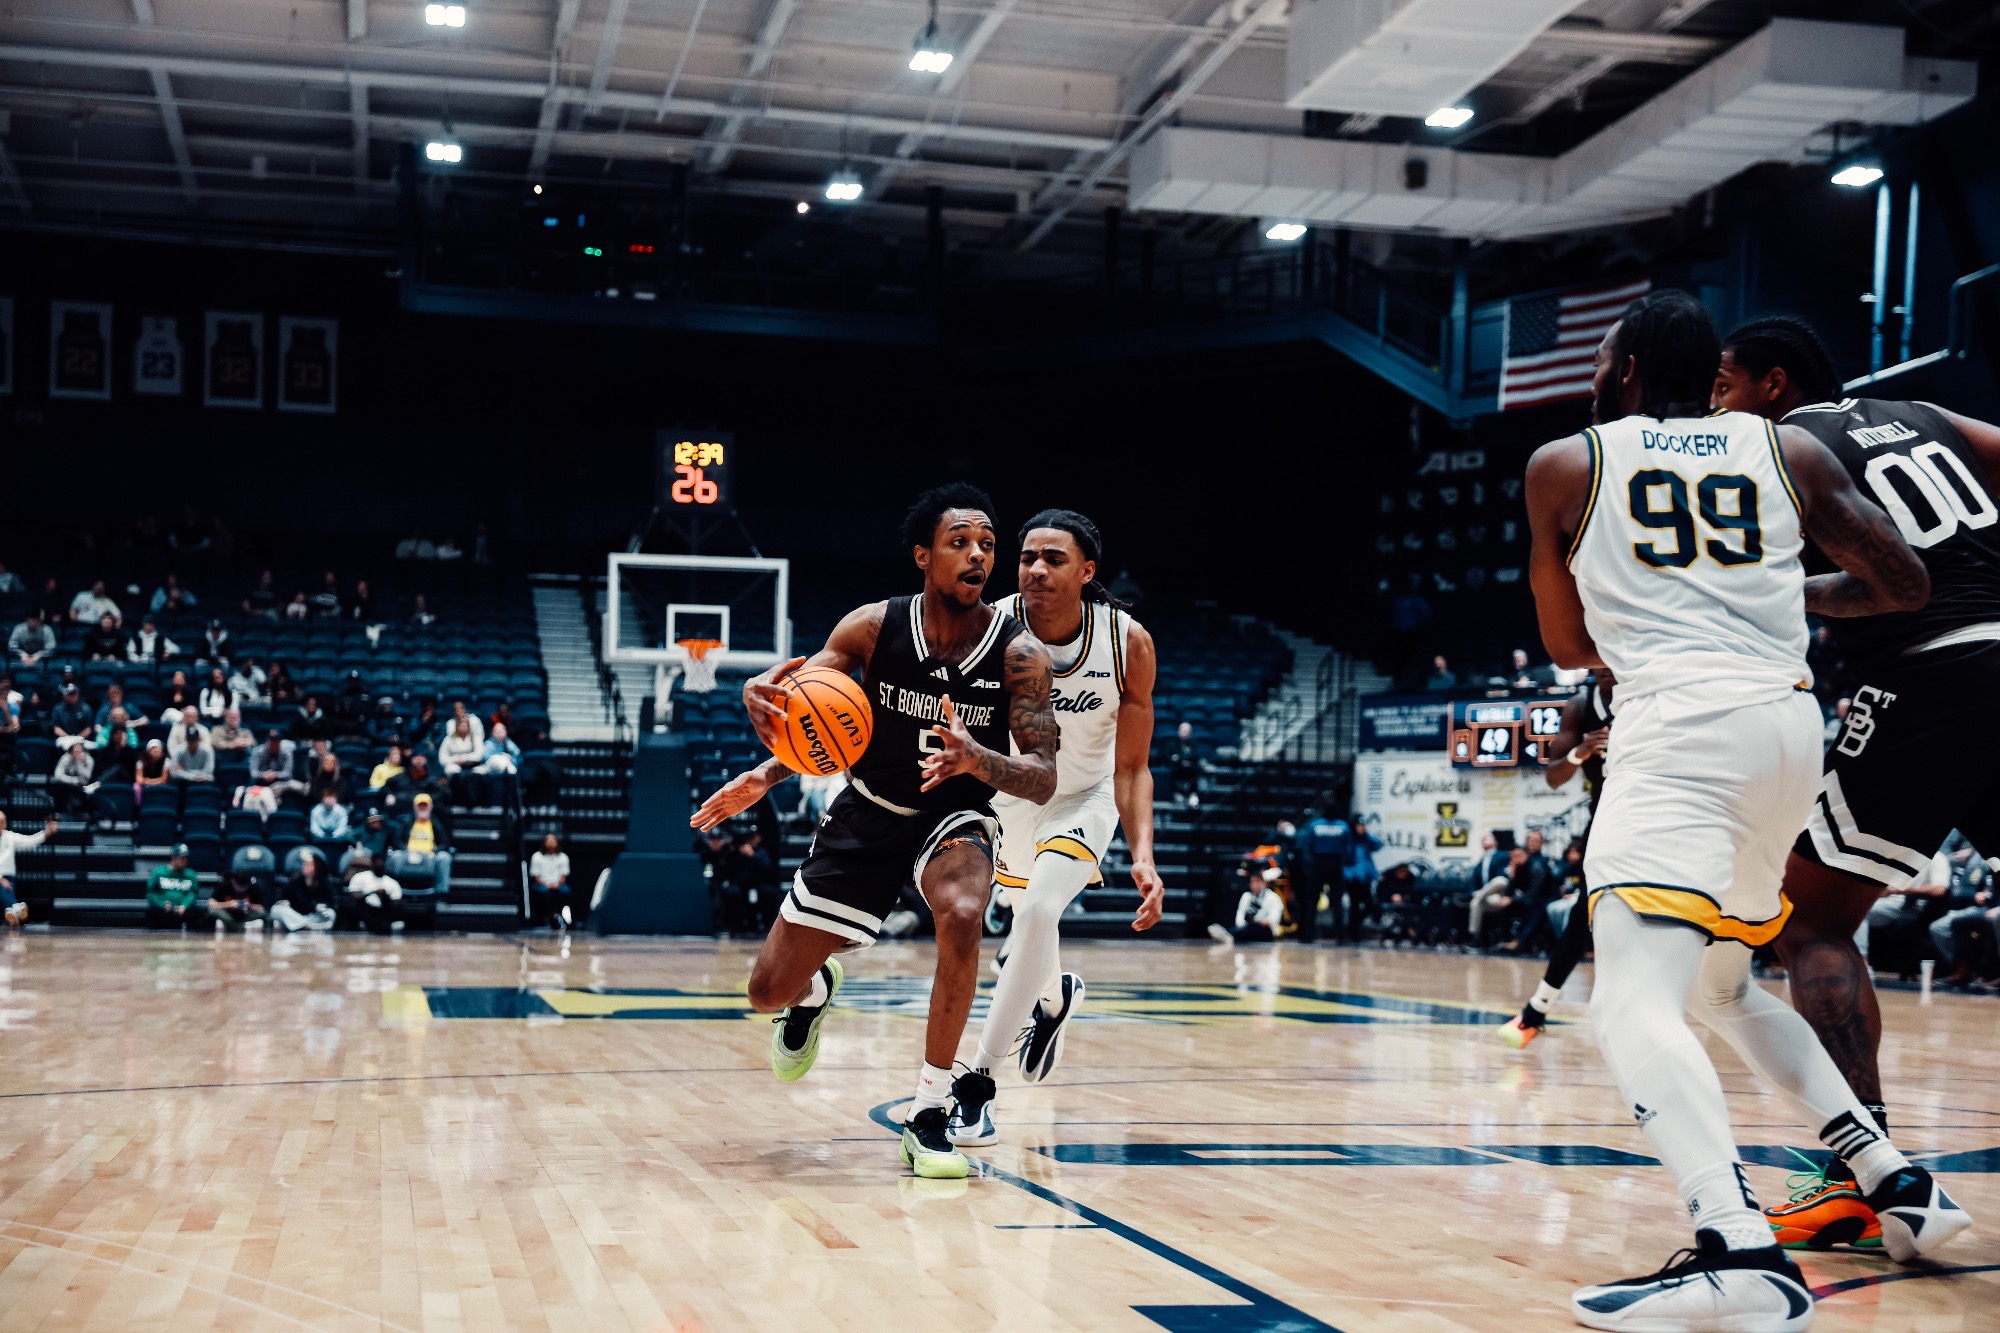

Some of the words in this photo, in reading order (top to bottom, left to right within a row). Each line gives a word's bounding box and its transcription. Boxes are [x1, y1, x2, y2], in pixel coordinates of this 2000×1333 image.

[142, 352, 175, 379] 23
[1641, 430, 1729, 457] DOCKERY
[1846, 420, 1920, 449] MITCHELL
[674, 441, 724, 467] 12:39
[671, 464, 719, 505] 26
[1864, 440, 1999, 549] 00
[1627, 467, 1764, 570] 99
[970, 678, 1001, 689] A10
[1082, 670, 1111, 678] A10
[879, 681, 895, 711] ST.
[799, 712, 840, 775] Wilson
